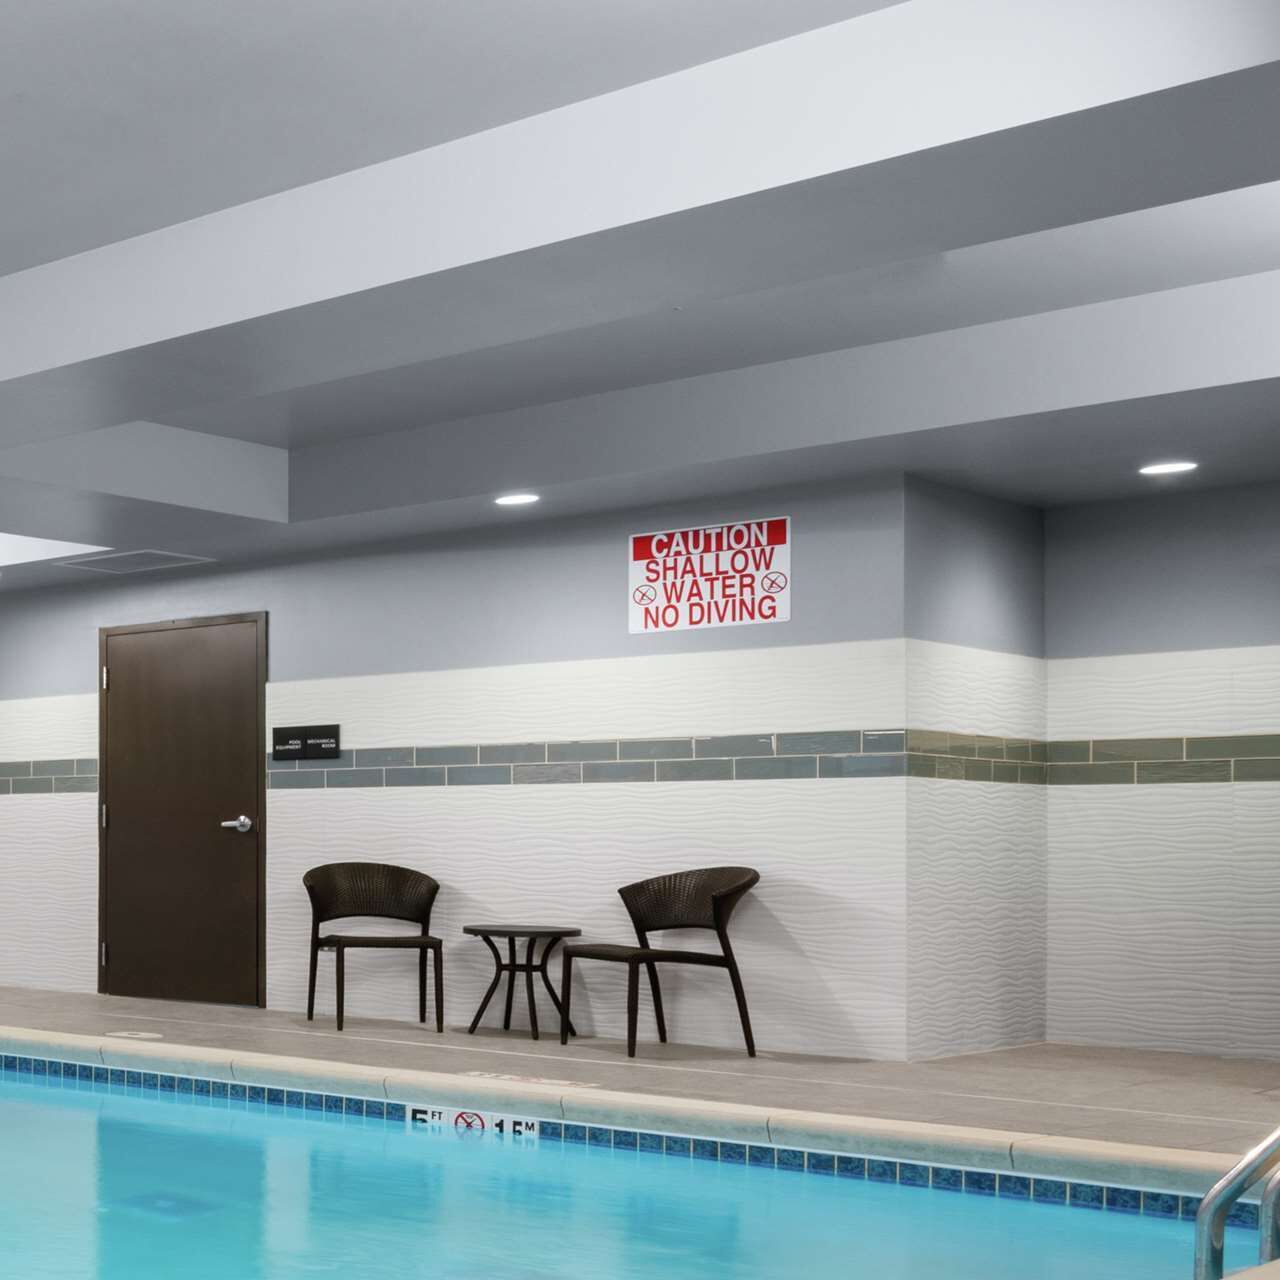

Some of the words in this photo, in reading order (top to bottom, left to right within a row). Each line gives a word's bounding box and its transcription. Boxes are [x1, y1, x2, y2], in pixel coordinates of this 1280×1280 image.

[651, 521, 768, 559] CAUTION
[645, 547, 775, 583] SHALLOW
[662, 573, 756, 604] WATER
[644, 604, 679, 630] NO
[689, 595, 777, 626] DIVING
[431, 1111, 443, 1120] FT
[525, 1121, 535, 1132] M
